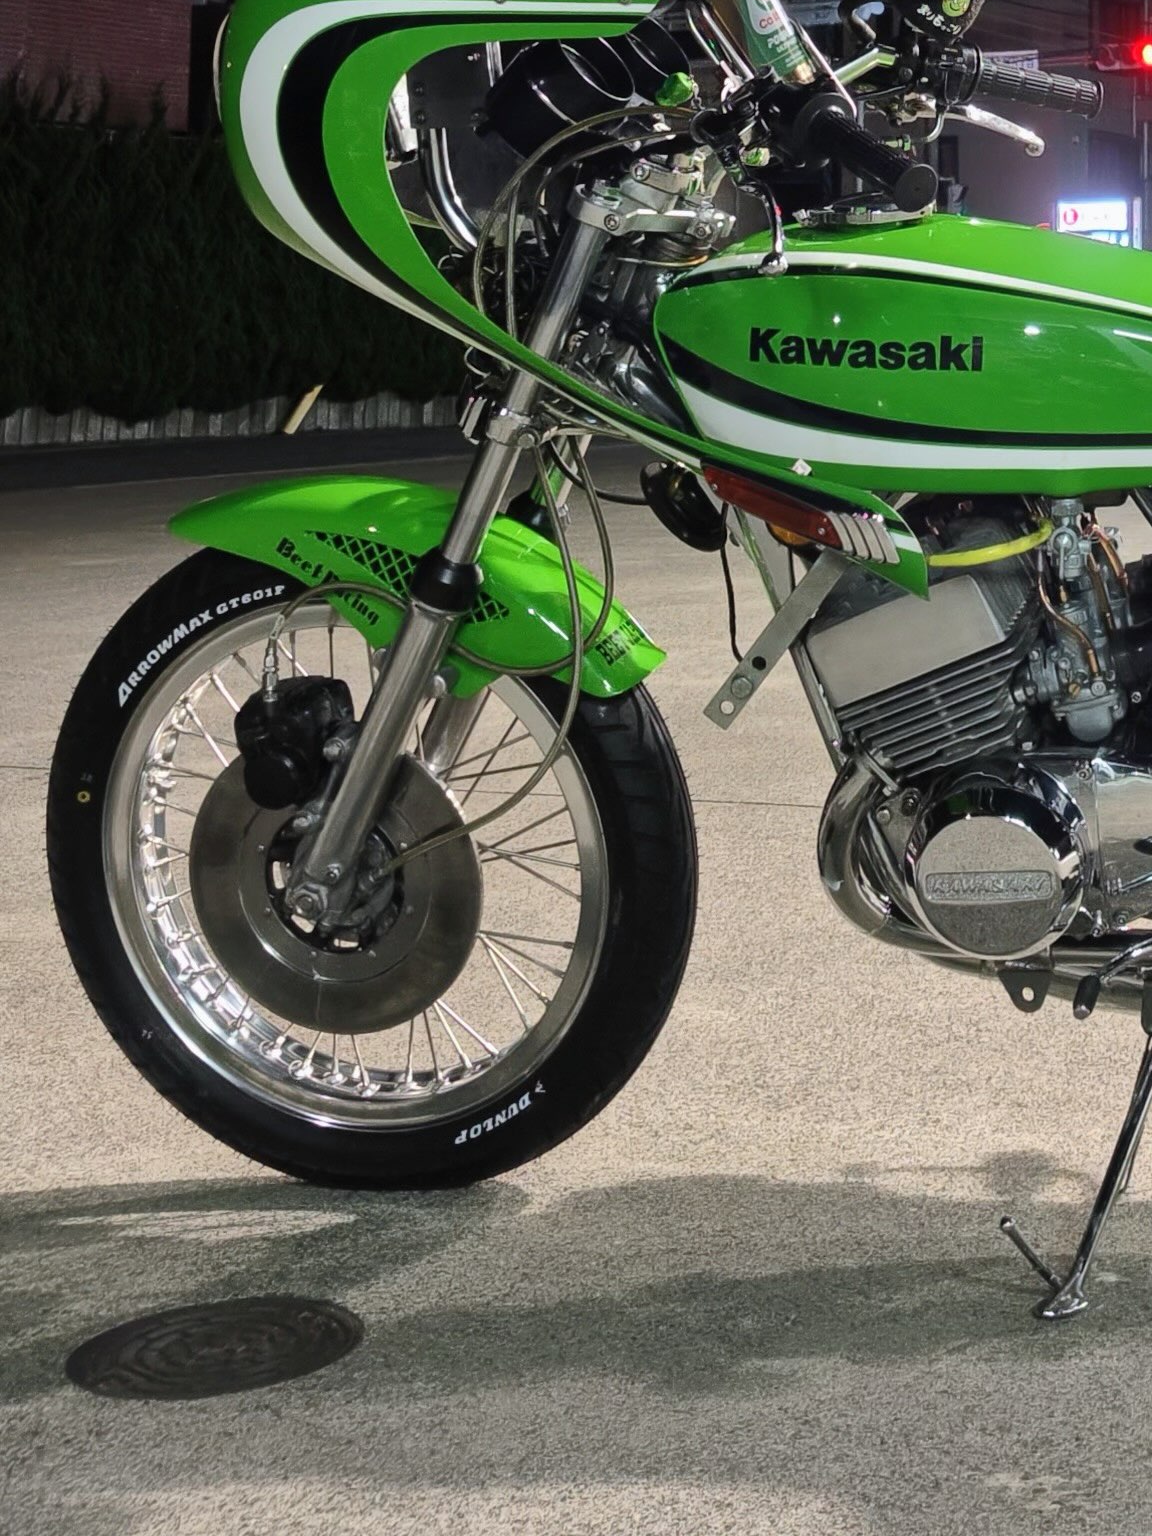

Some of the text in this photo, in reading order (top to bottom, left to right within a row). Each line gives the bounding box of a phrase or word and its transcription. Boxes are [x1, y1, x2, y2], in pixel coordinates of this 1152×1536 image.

[749, 326, 984, 372] Kawasaki
[117, 584, 286, 708] ARROWMAX GT601F
[932, 875, 1047, 895] KAWASAKI
[454, 1091, 533, 1145] DUNLOP
